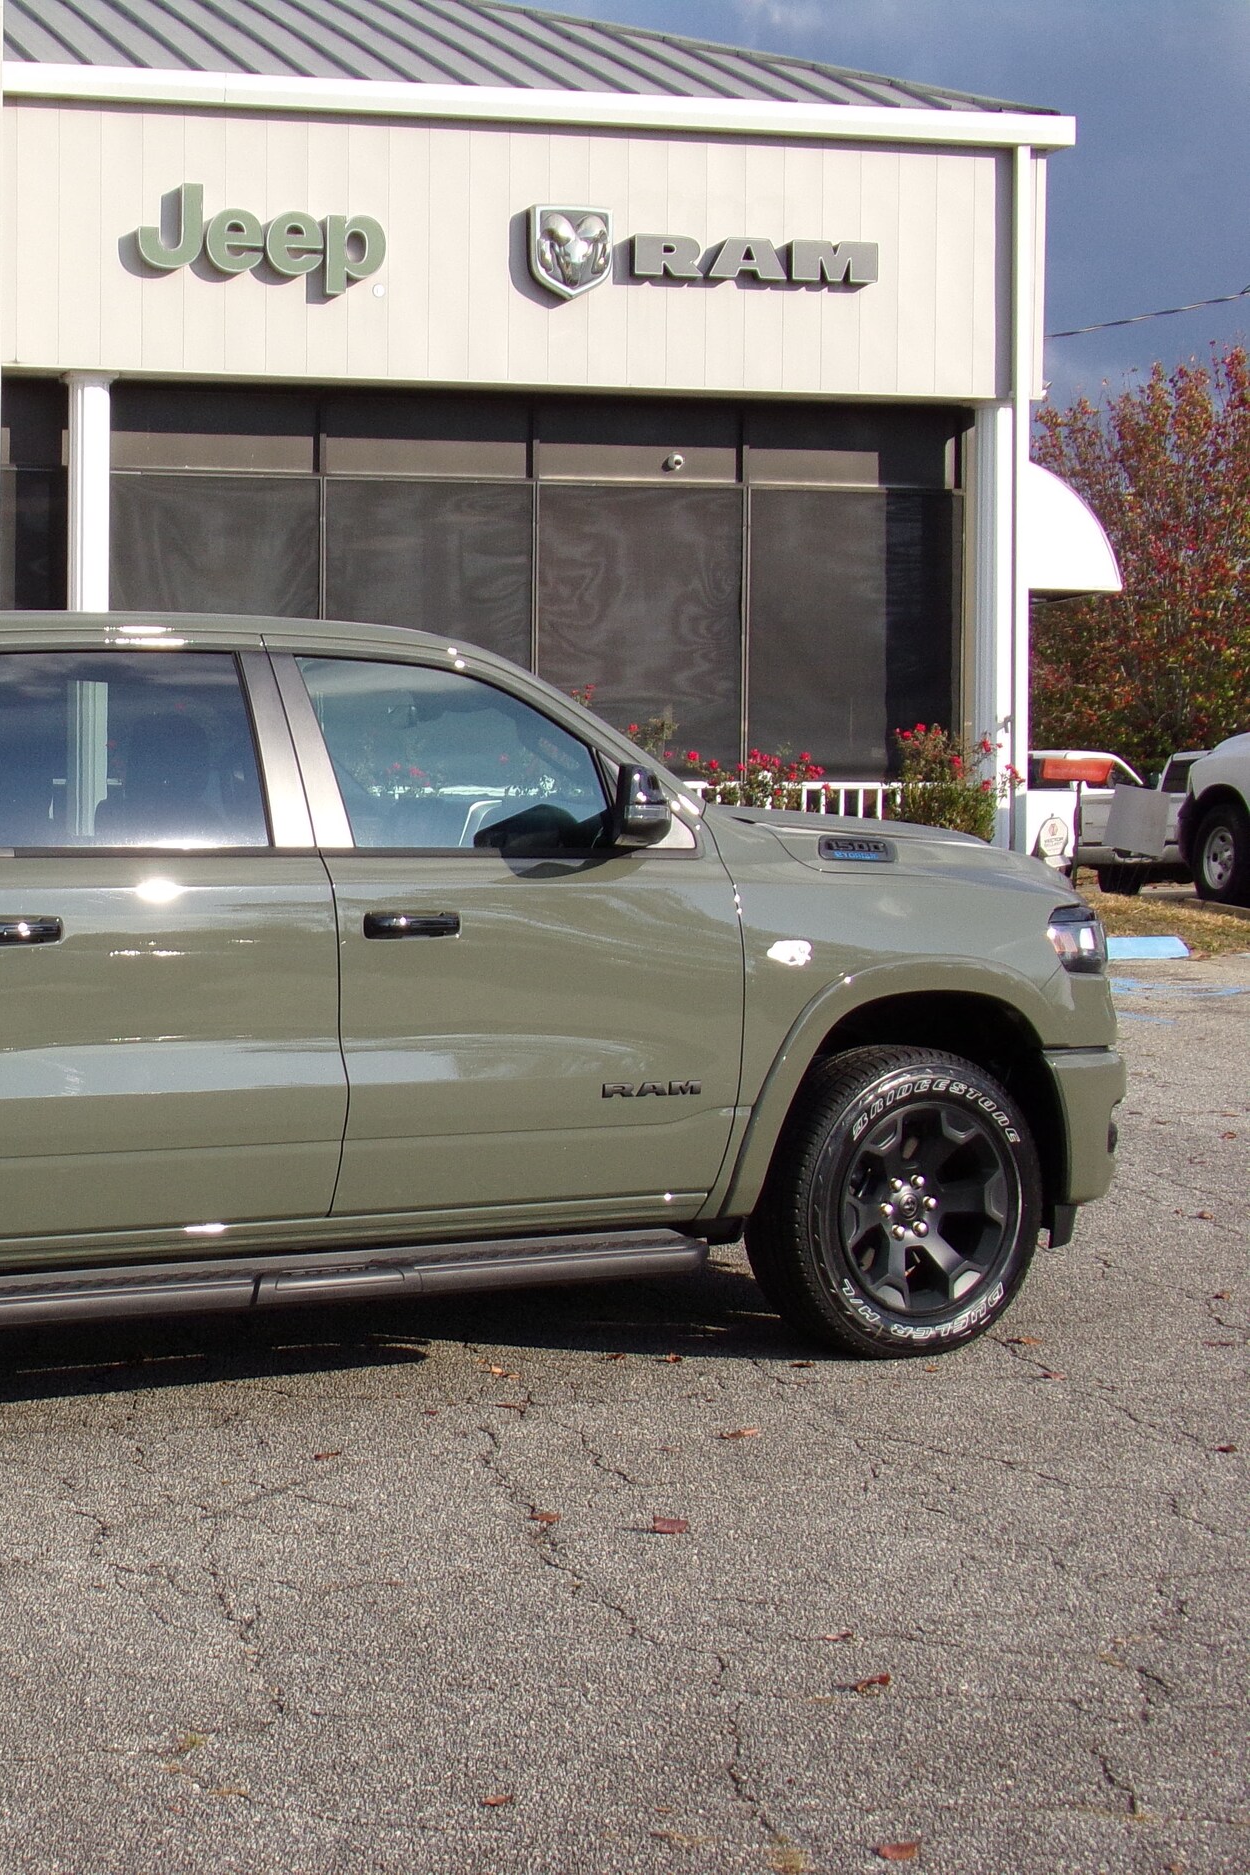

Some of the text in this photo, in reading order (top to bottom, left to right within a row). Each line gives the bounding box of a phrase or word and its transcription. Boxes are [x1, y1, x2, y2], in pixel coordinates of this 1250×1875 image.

[137, 182, 388, 297] Jeep
[631, 232, 880, 287] RAM
[827, 839, 885, 853] 1500
[602, 1079, 702, 1098] RAM
[852, 1078, 1022, 1143] BRIDGESTONE
[890, 1281, 1005, 1340] DUELER
